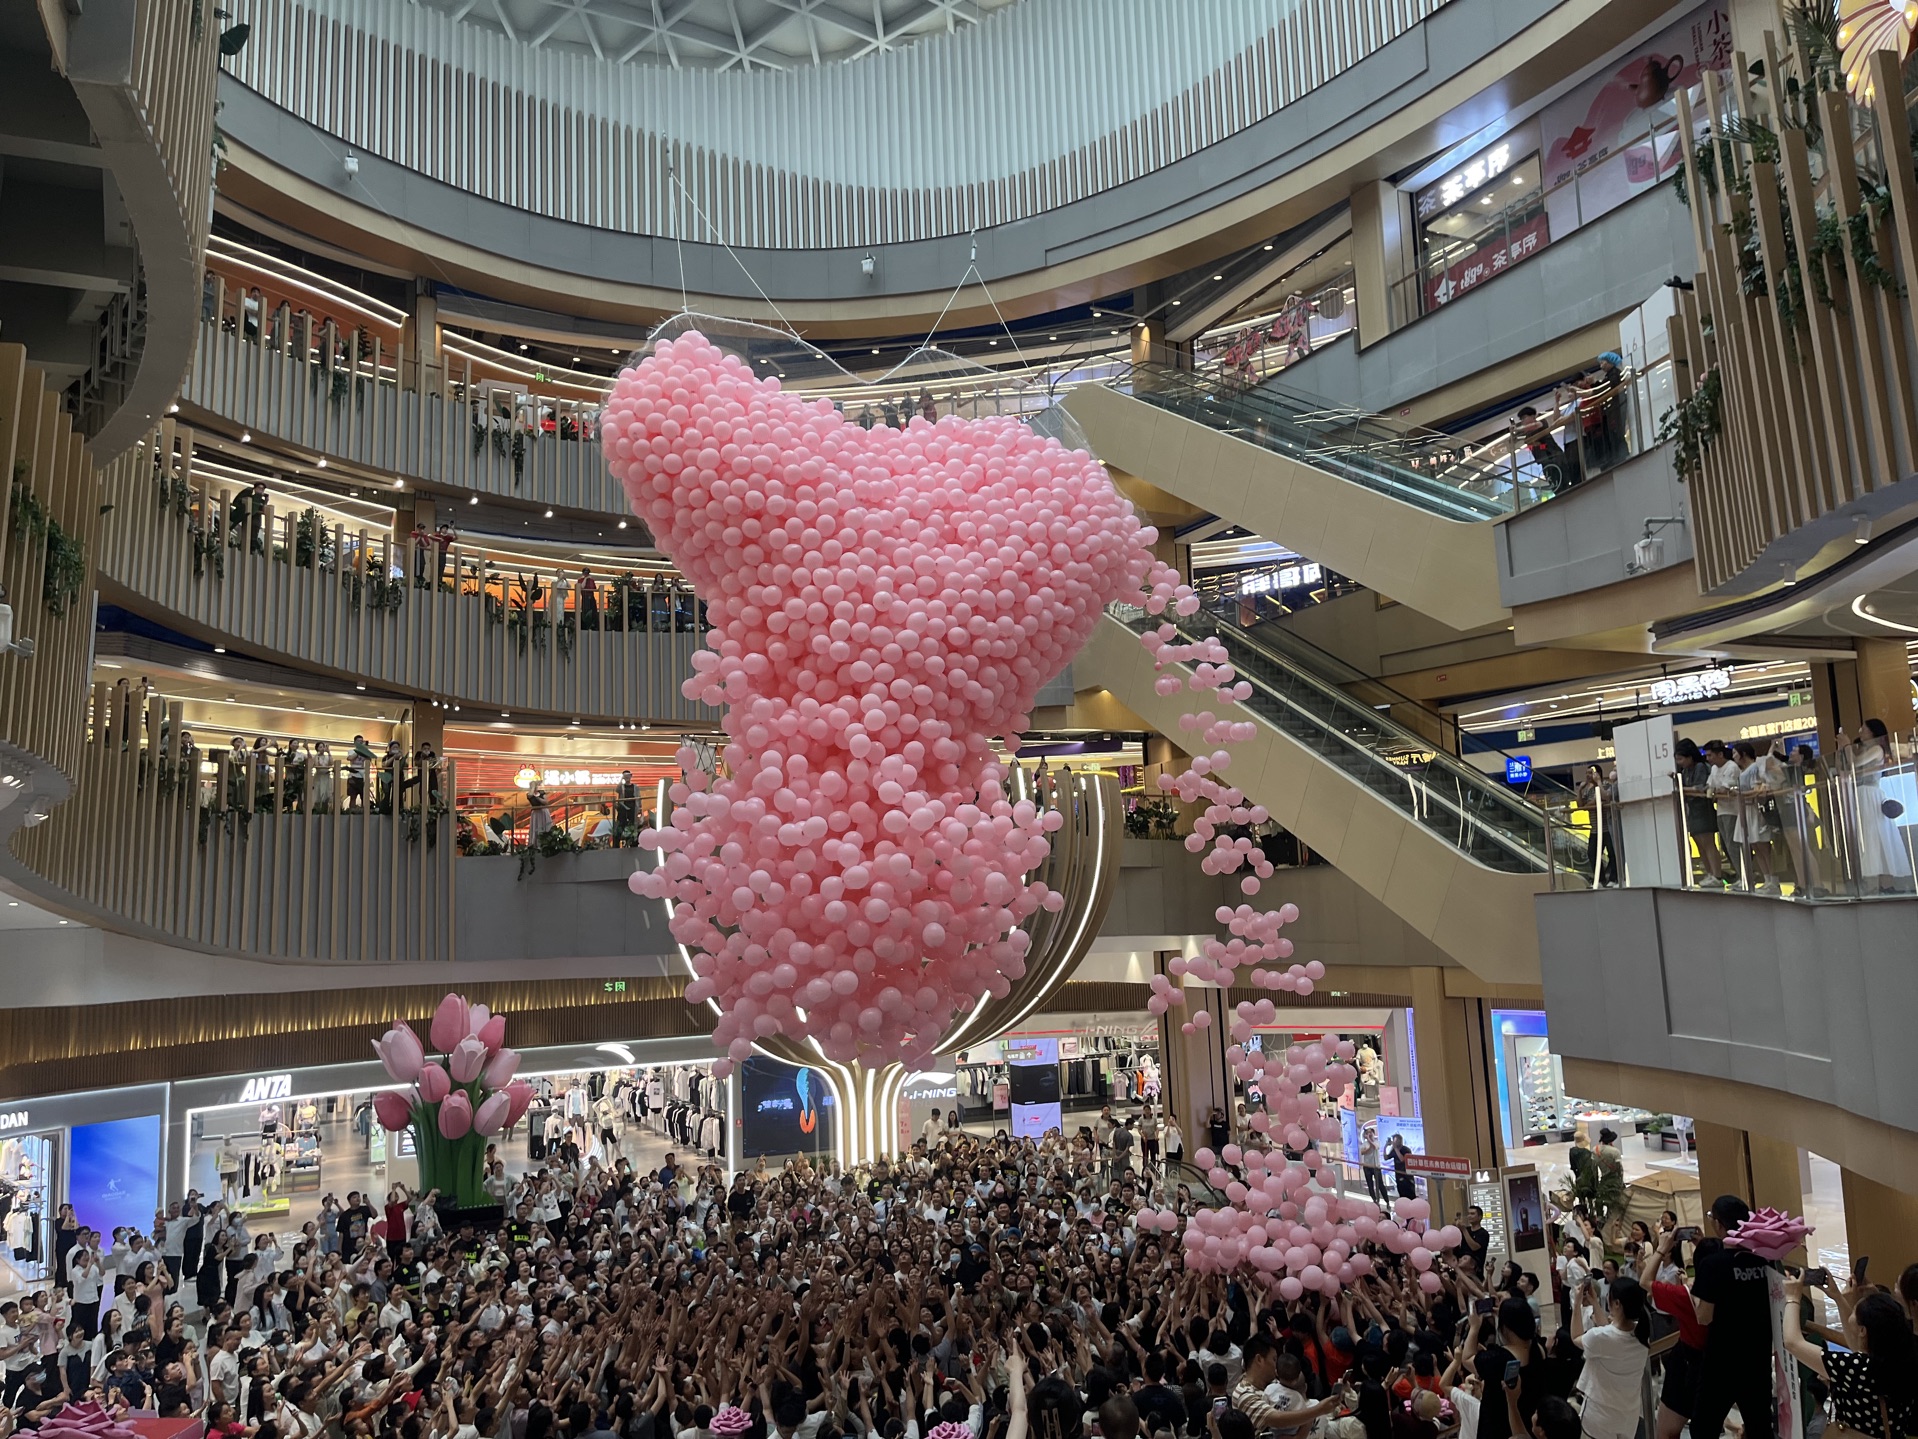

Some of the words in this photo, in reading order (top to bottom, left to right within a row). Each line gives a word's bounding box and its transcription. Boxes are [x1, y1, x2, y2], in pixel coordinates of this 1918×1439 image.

[1441, 144, 1509, 207] 茶亭序
[1492, 232, 1537, 271] 茶亭序
[1654, 743, 1669, 759] L5
[239, 1074, 292, 1102] ANTA
[0, 1111, 28, 1130] DAN
[1733, 1266, 1767, 1282] POPEY
